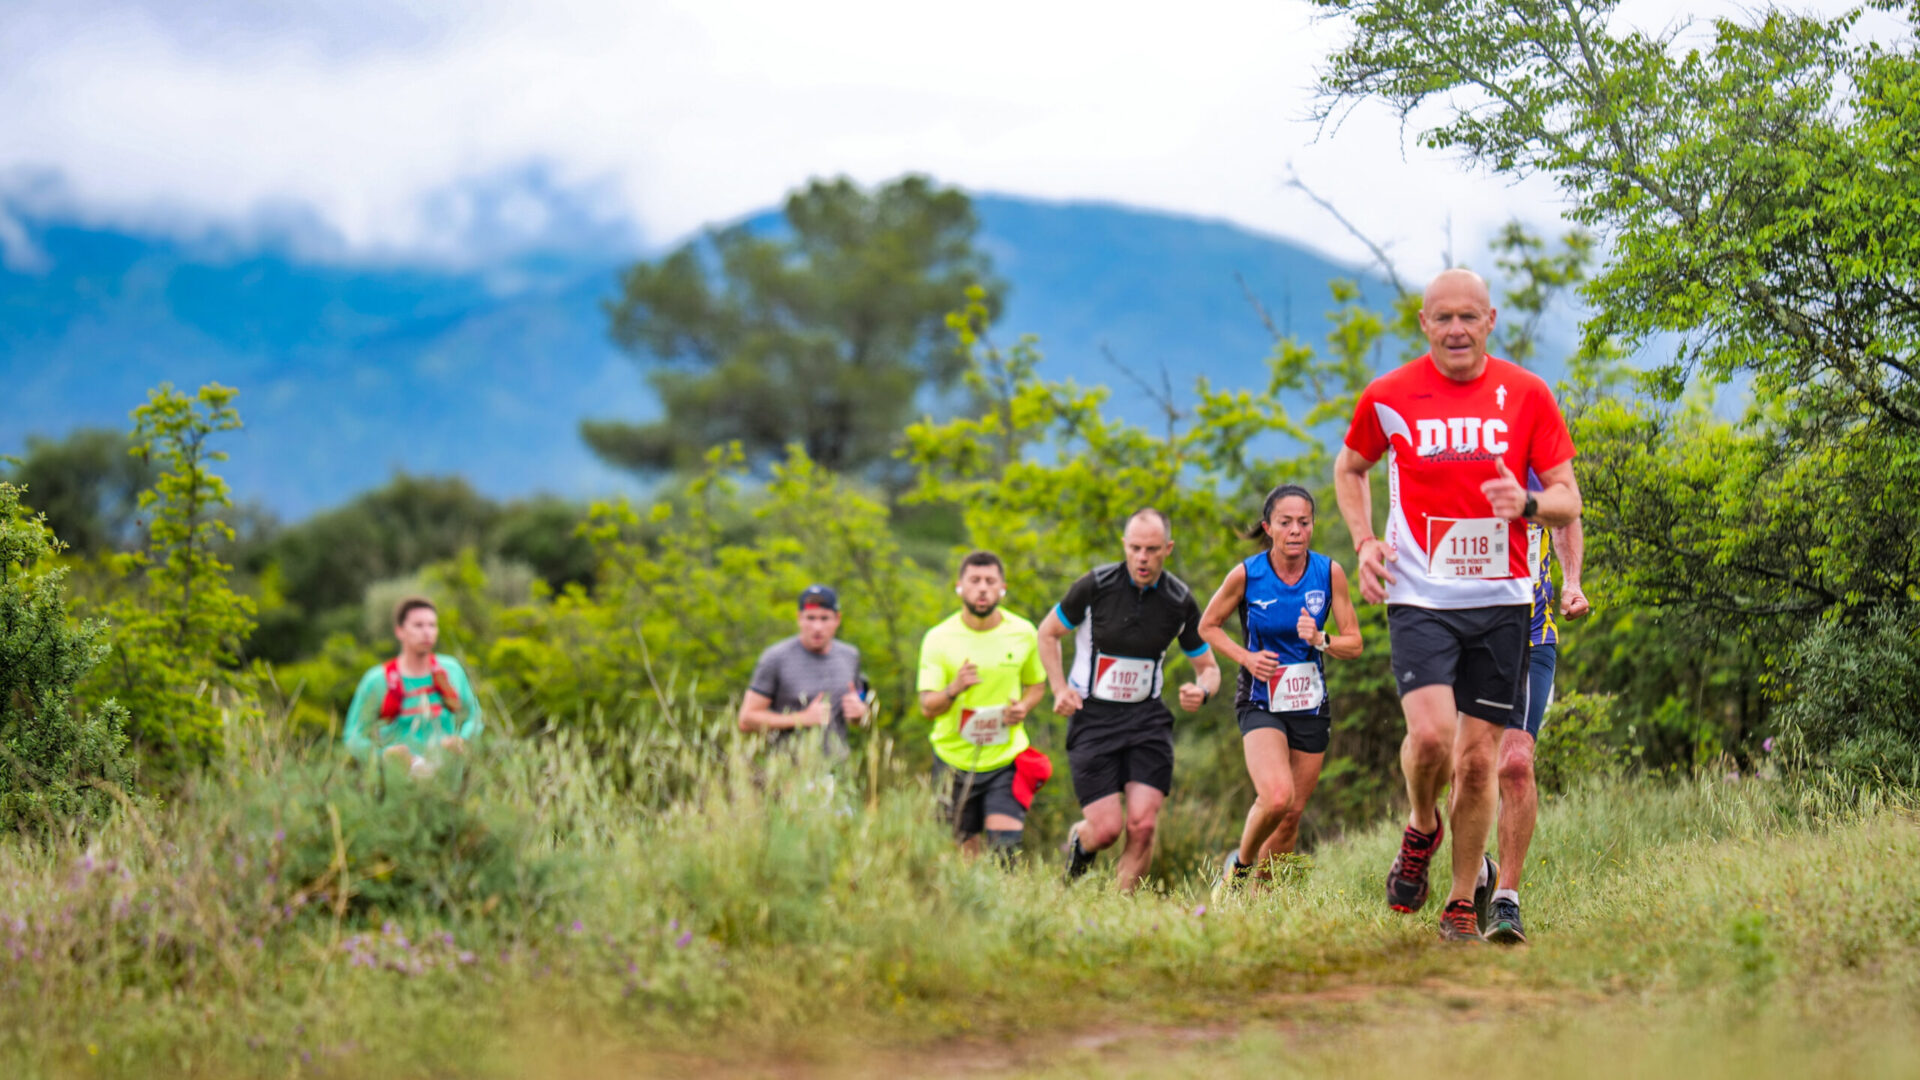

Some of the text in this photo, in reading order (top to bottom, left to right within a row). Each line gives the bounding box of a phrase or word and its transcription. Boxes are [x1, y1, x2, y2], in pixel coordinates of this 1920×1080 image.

[1416, 417, 1508, 456] DUC
[1450, 536, 1488, 555] 1118
[1456, 566, 1482, 575] 13 KM
[1112, 670, 1138, 685] 1107
[1286, 677, 1310, 692] 1073
